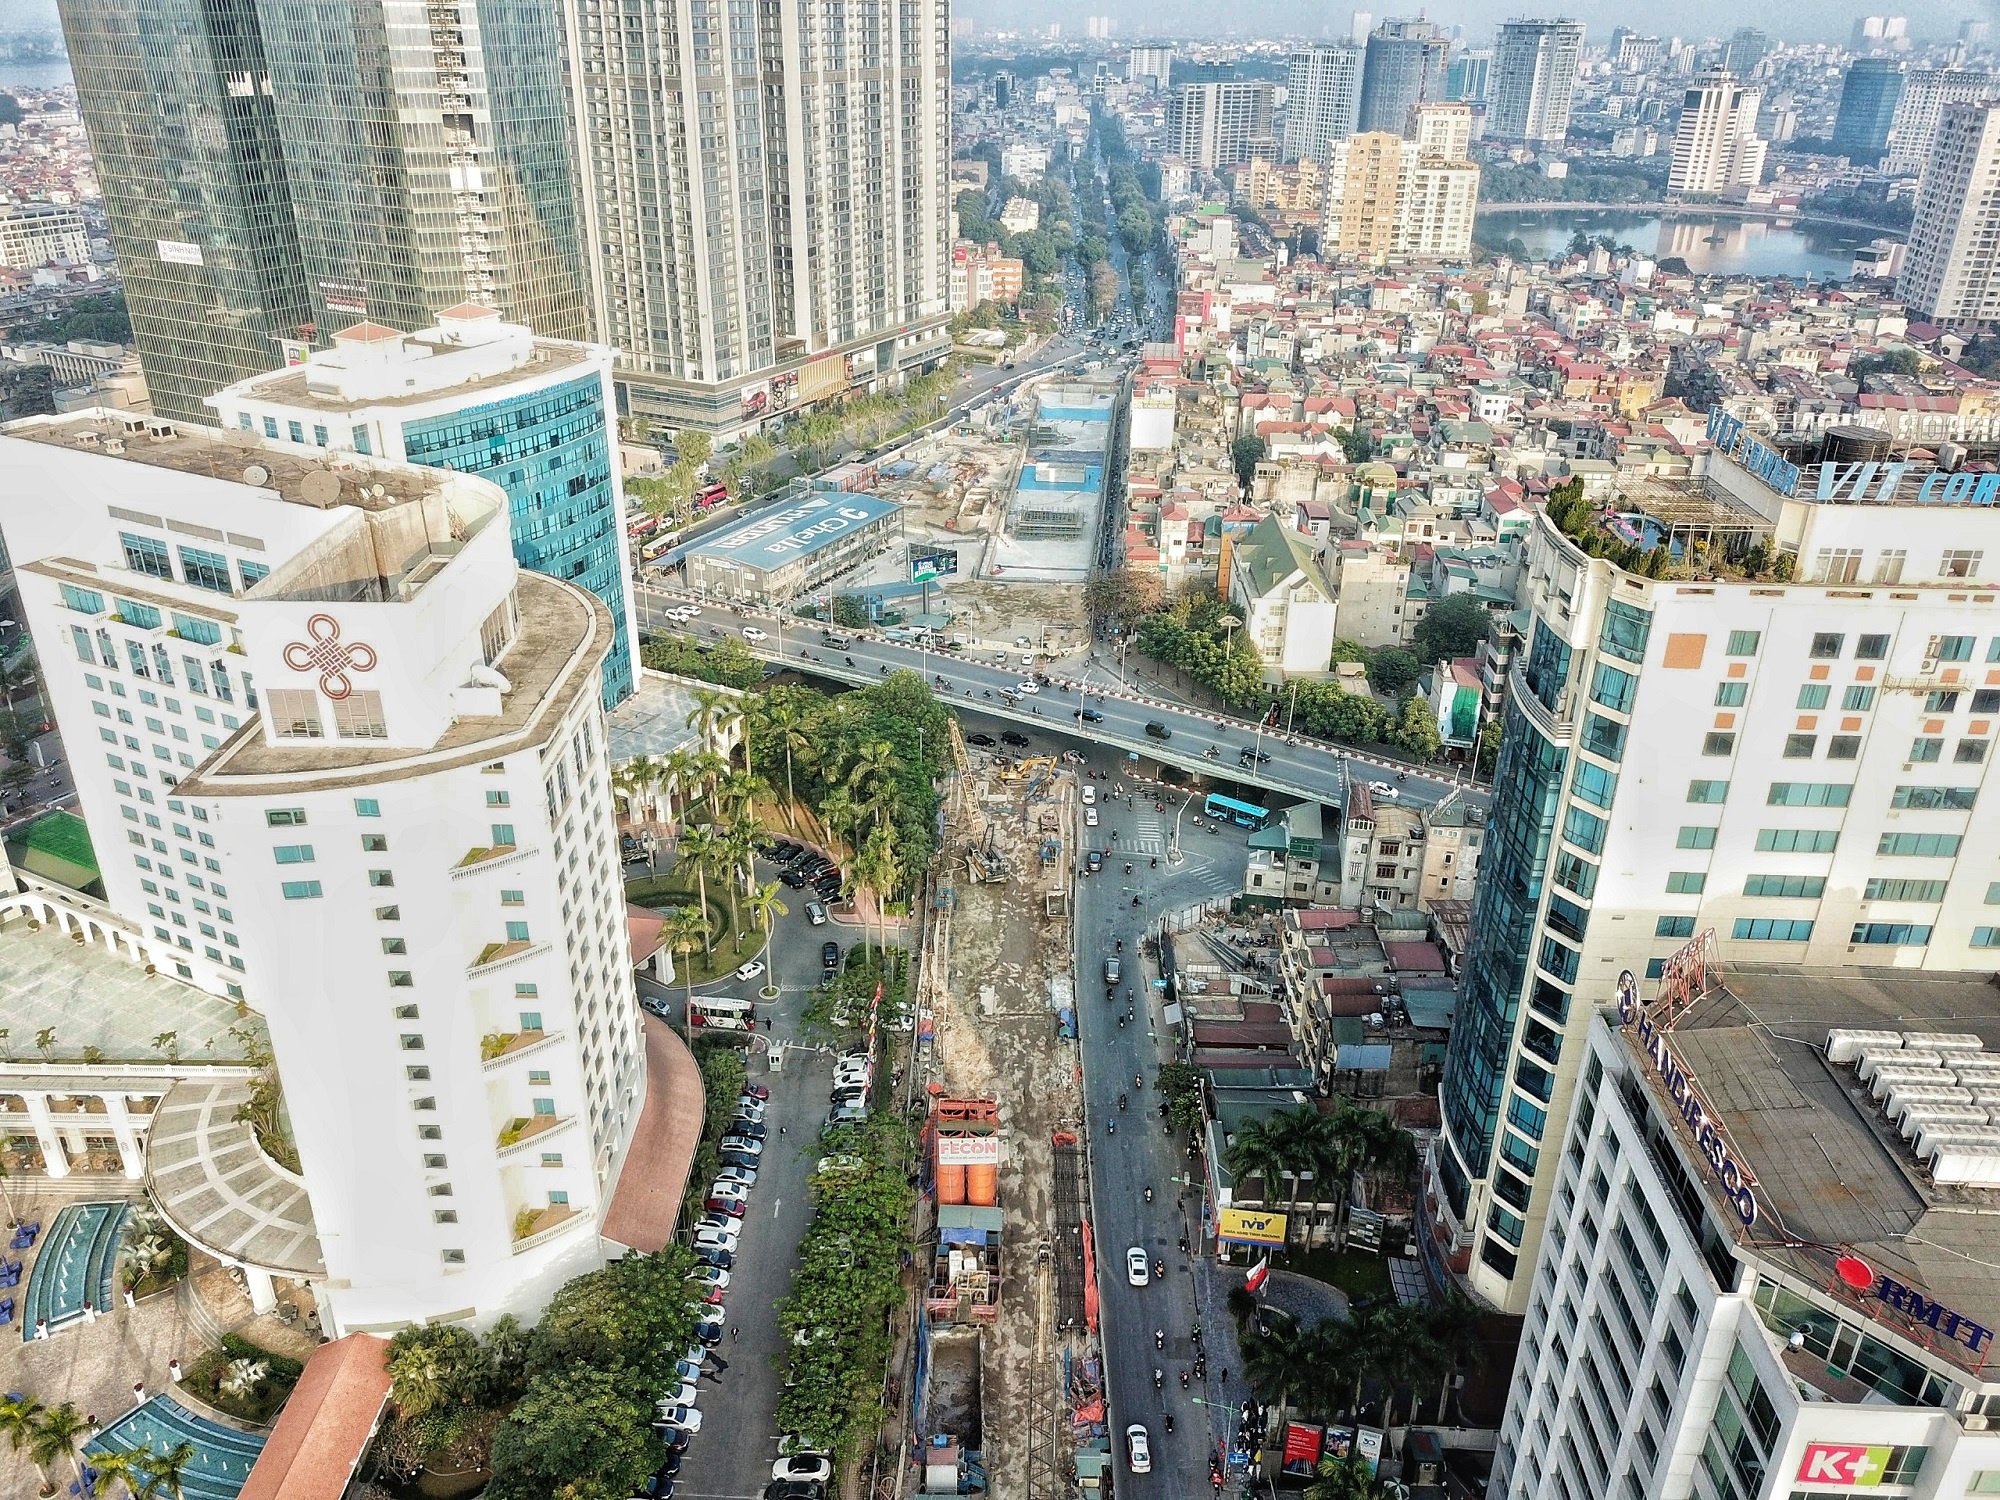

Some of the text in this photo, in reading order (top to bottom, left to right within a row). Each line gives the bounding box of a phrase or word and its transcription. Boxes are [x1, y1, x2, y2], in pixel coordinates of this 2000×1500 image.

[1706, 403, 1799, 497] VIT TOWER
[1816, 461, 1915, 501] VIT
[716, 507, 814, 549] HYUNDAI
[764, 517, 849, 553] Ghella
[1637, 1010, 1758, 1226] HANDIRESCO
[940, 1142, 997, 1154] FECON
[1875, 1274, 1995, 1354] RMIT
[1807, 1449, 1879, 1480] K+
